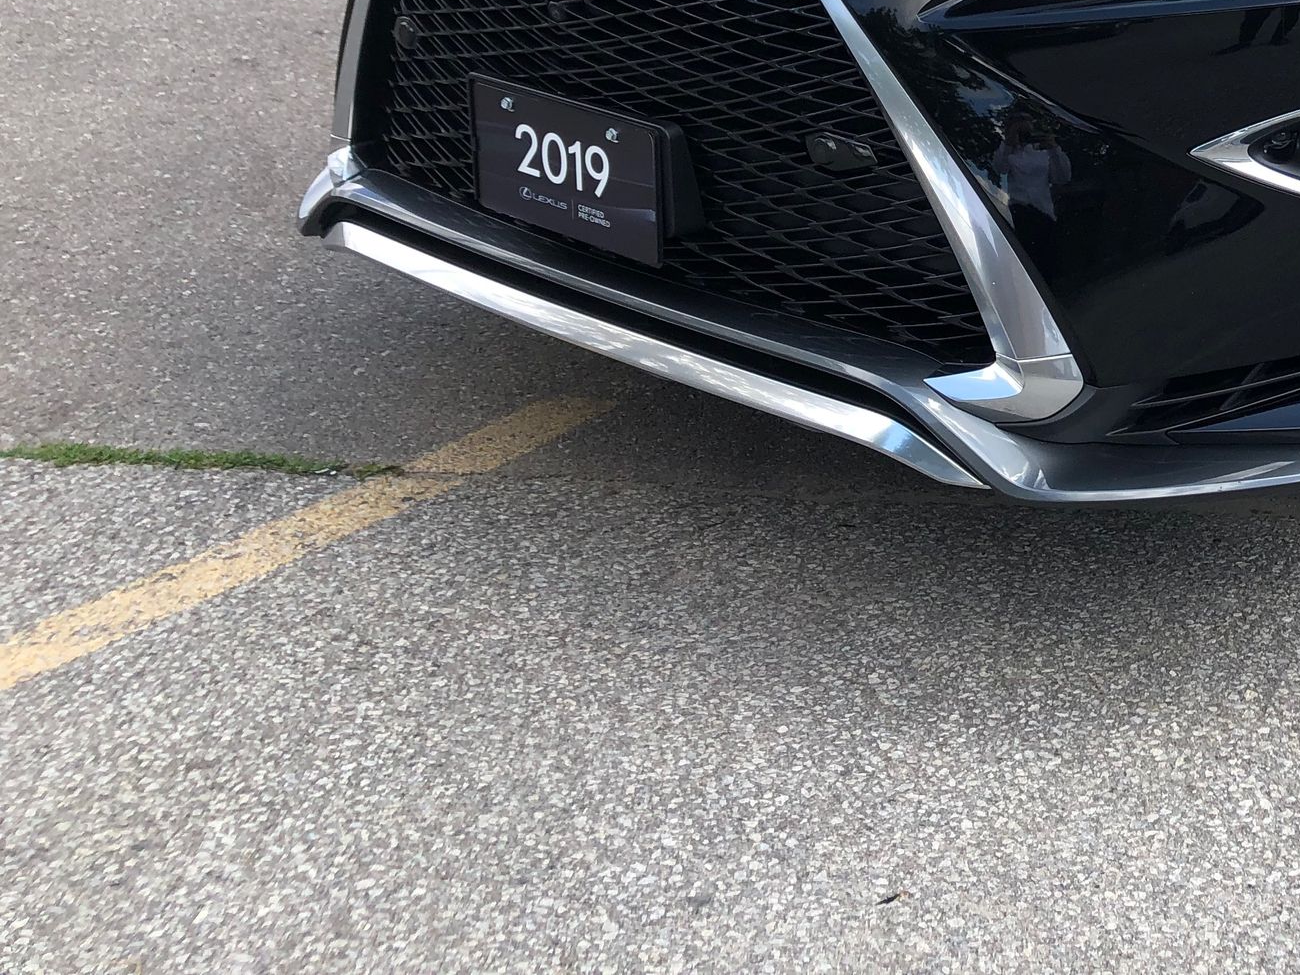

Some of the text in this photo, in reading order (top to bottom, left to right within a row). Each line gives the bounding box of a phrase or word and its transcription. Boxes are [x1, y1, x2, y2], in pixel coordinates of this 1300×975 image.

[514, 123, 610, 198] 2019
[532, 192, 568, 210] LEXUS
[577, 204, 605, 219] CERTIFIED
[577, 212, 611, 228] PRE-OWNED
